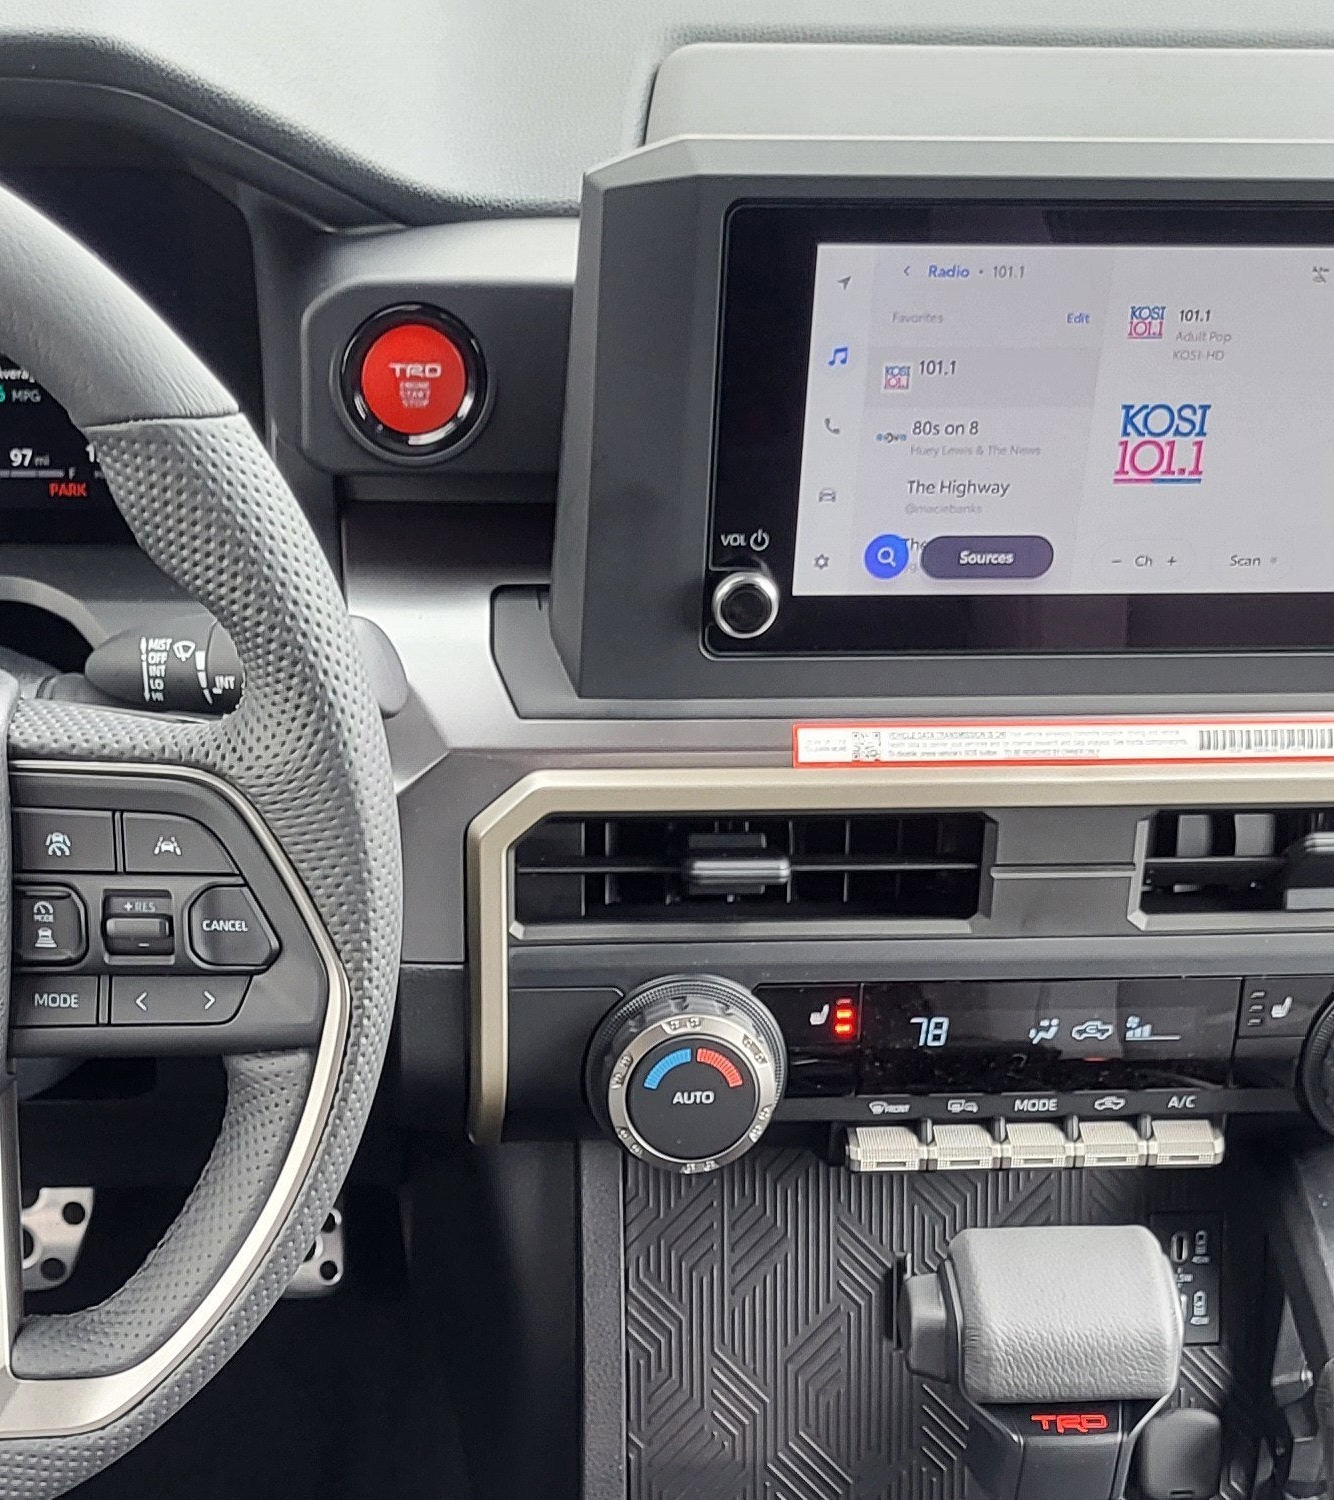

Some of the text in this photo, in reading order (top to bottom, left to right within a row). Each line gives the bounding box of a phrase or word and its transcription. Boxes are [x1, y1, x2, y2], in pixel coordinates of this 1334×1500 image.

[928, 265, 1025, 279] Radio 101.1
[892, 312, 1090, 325] Favorites Edit
[1130, 306, 1166, 320] KOSI
[1179, 309, 1211, 322] 101.1
[1128, 321, 1163, 337] 101.1
[1210, 331, 1232, 344] Pop
[388, 363, 442, 378] TRD
[919, 360, 957, 375] 101.1
[11, 389, 42, 402] MPG
[1121, 404, 1211, 437] KOSI
[912, 421, 979, 435] 80s on 8
[10, 448, 33, 466] 97
[1114, 440, 1203, 477] 101.1
[49, 482, 88, 497] PARK
[908, 480, 1010, 497] The Highway
[721, 535, 746, 546] VOL
[959, 551, 1014, 564] Sources
[1134, 556, 1153, 567] Ch
[1229, 555, 1261, 567] Scan
[148, 638, 173, 651] MIST
[148, 652, 167, 664] OFF
[149, 665, 166, 677] INT
[150, 678, 164, 690] LO
[202, 919, 248, 932] CANCEL
[34, 993, 79, 1007] MODE
[910, 1017, 950, 1046] 78
[672, 1091, 715, 1104] AUTO
[1167, 1095, 1196, 1109] A/C
[1014, 1099, 1058, 1112] MODE
[1030, 1413, 1109, 1434] TRD
